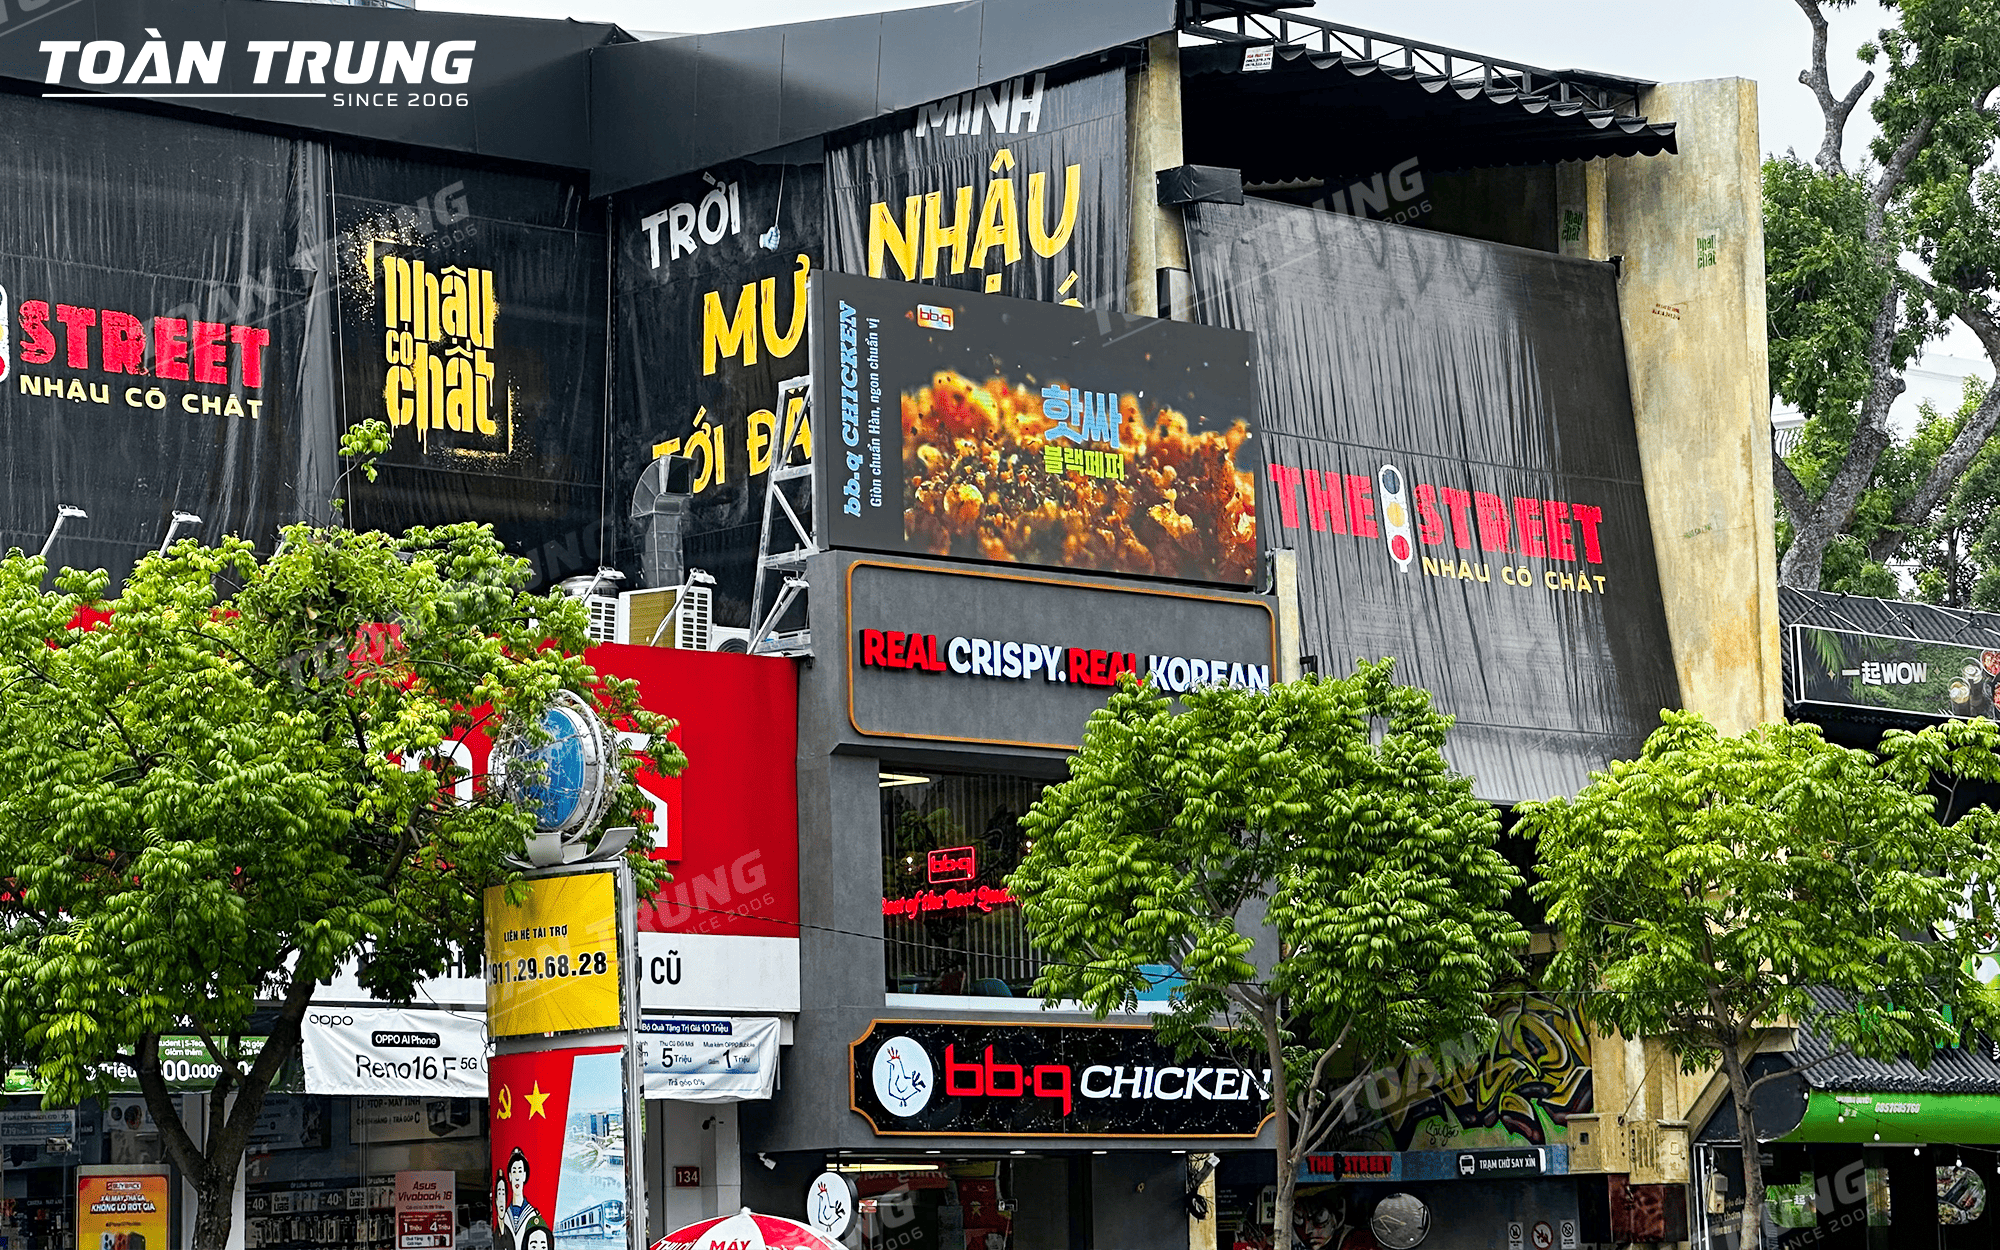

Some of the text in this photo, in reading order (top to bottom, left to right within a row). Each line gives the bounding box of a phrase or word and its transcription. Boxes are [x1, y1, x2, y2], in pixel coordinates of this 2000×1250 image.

[641, 171, 741, 269] TRỜI
[868, 148, 1081, 294] NHẬU
[383, 265, 495, 350] nhậu
[18, 299, 270, 389] STREET
[839, 300, 860, 447] CHICKEN
[868, 373, 882, 404] ngon
[385, 342, 497, 440] chất
[1041, 384, 1122, 448] 핫싸
[1044, 445, 1124, 481] 블랙페퍼
[869, 478, 882, 507] Giòn
[1268, 463, 1603, 564] THE STREET
[862, 628, 1270, 695] REAL CRISPY. REAL KOREAN
[504, 929, 518, 942] LIÊN
[650, 949, 682, 985] CŨ
[375, 1034, 400, 1044] OPPO
[411, 1036, 437, 1046] Phone
[702, 1024, 710, 1032] 10
[711, 1022, 729, 1033] Triệu
[356, 1054, 477, 1080] Reno16 F 5G
[661, 1048, 692, 1068] 5 Triệu
[723, 1050, 731, 1068] 1
[1079, 1065, 1271, 1101] CHICKEN
[677, 1171, 698, 1183] 134
[1308, 1155, 1393, 1173] THE STREET
[1511, 1157, 1524, 1168] SAY
[398, 1191, 441, 1201] Vivobook
[412, 1181, 437, 1191] Asus
[429, 1221, 438, 1232] 4
